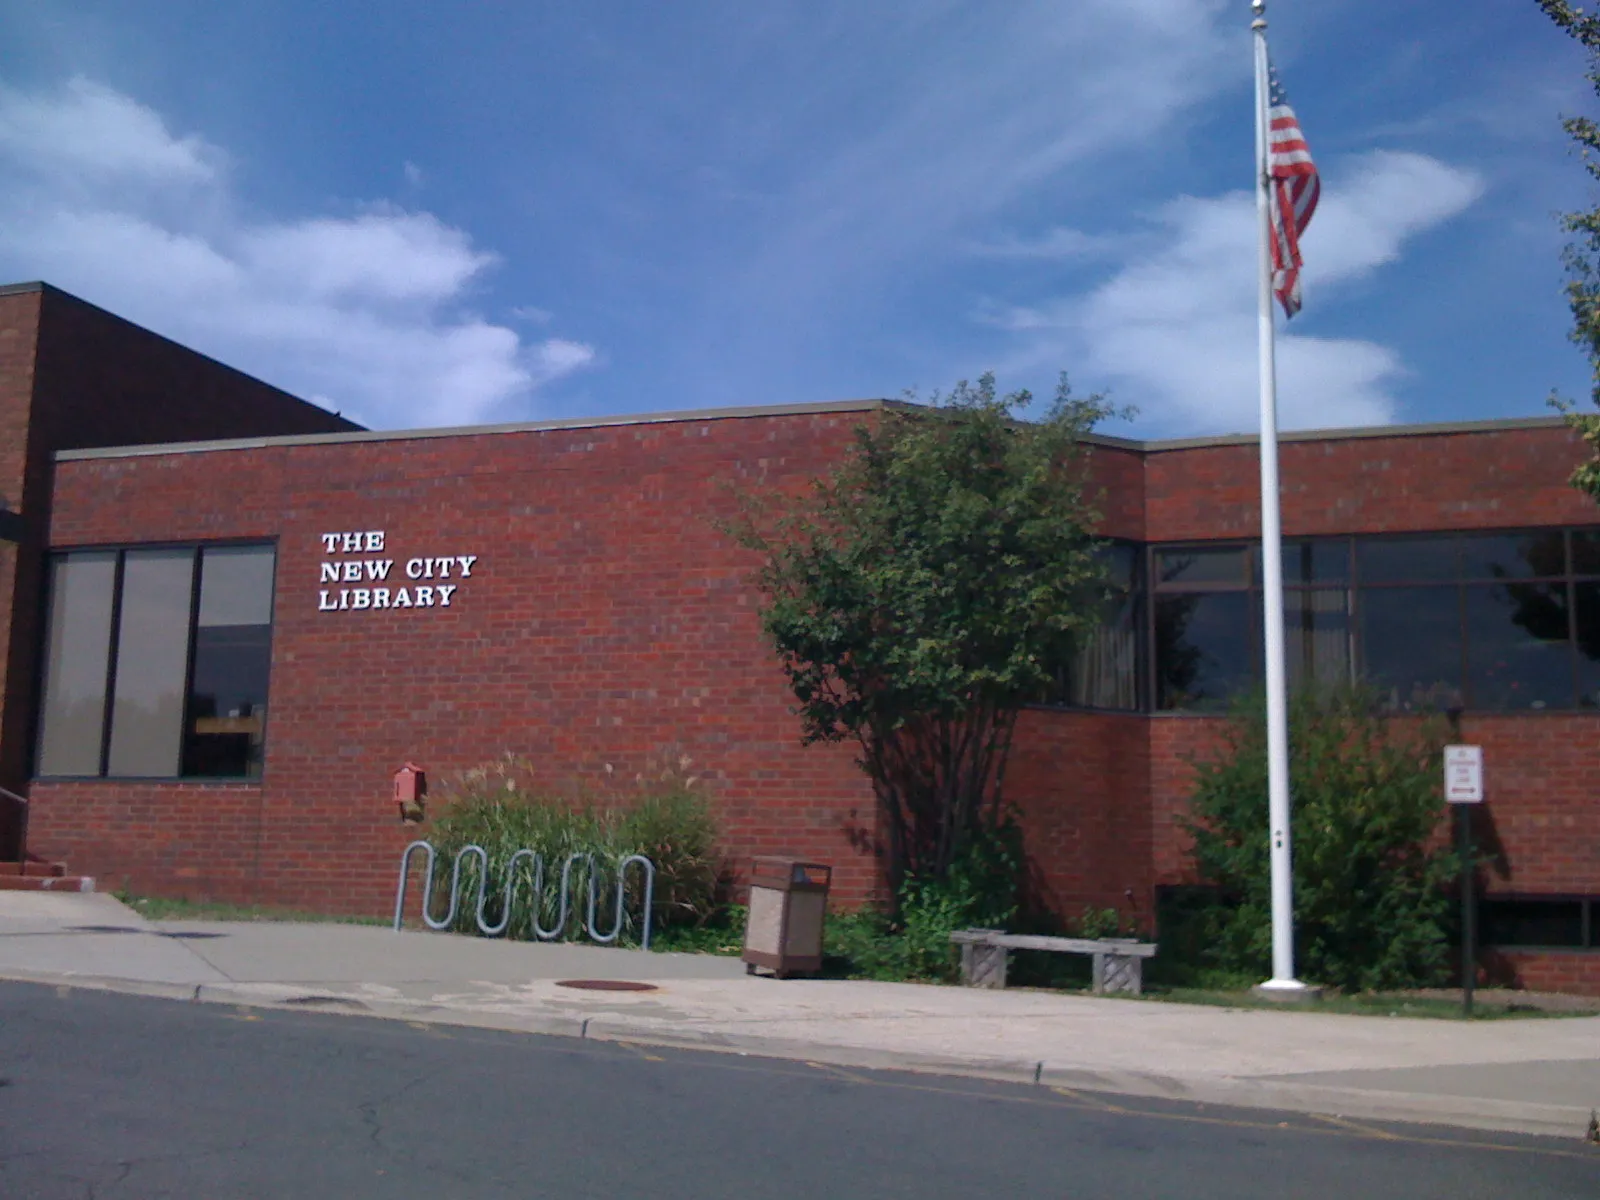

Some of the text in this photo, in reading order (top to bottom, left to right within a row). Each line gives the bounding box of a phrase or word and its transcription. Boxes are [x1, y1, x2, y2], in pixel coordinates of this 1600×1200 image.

[321, 530, 386, 553] THE
[319, 555, 478, 583] NEW CITY
[318, 584, 457, 611] LIBRARY
